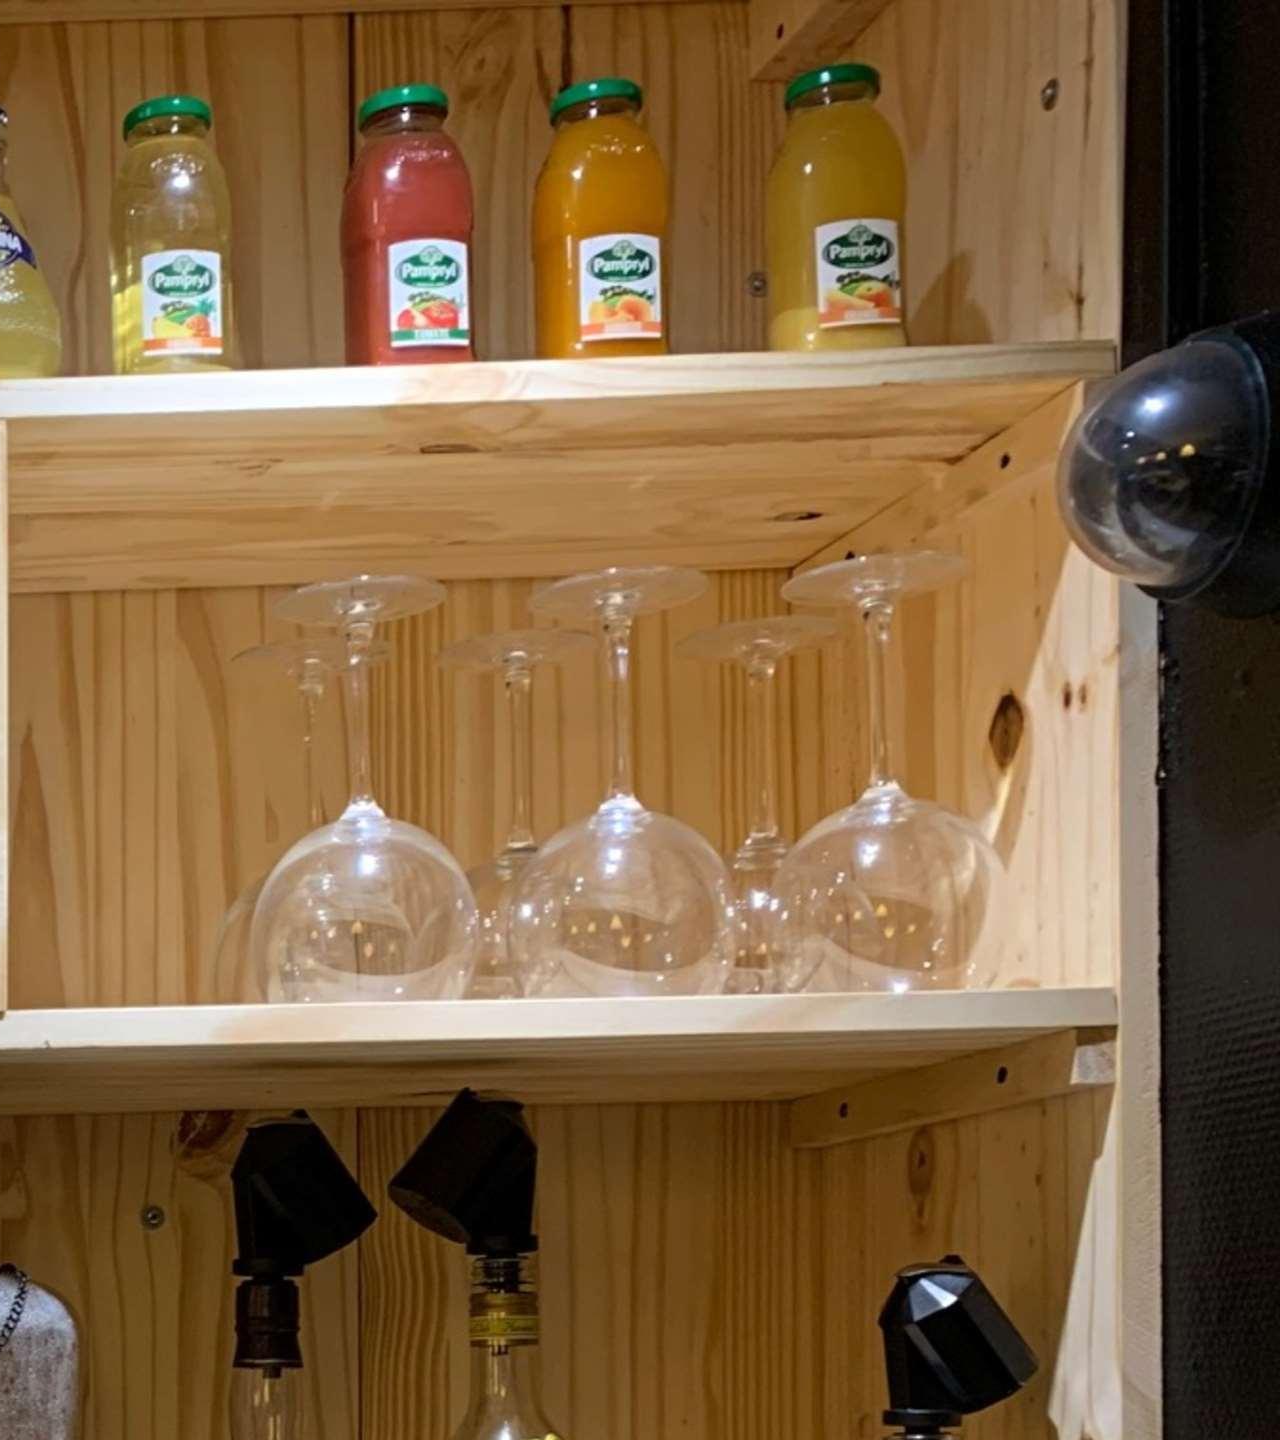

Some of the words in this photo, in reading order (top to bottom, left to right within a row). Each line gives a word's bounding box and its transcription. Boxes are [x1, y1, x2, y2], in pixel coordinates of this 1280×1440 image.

[829, 240, 888, 261] Pampryl
[402, 262, 457, 281] Pampryl
[593, 256, 650, 275] Pampryl
[155, 271, 210, 290] Pampryl
